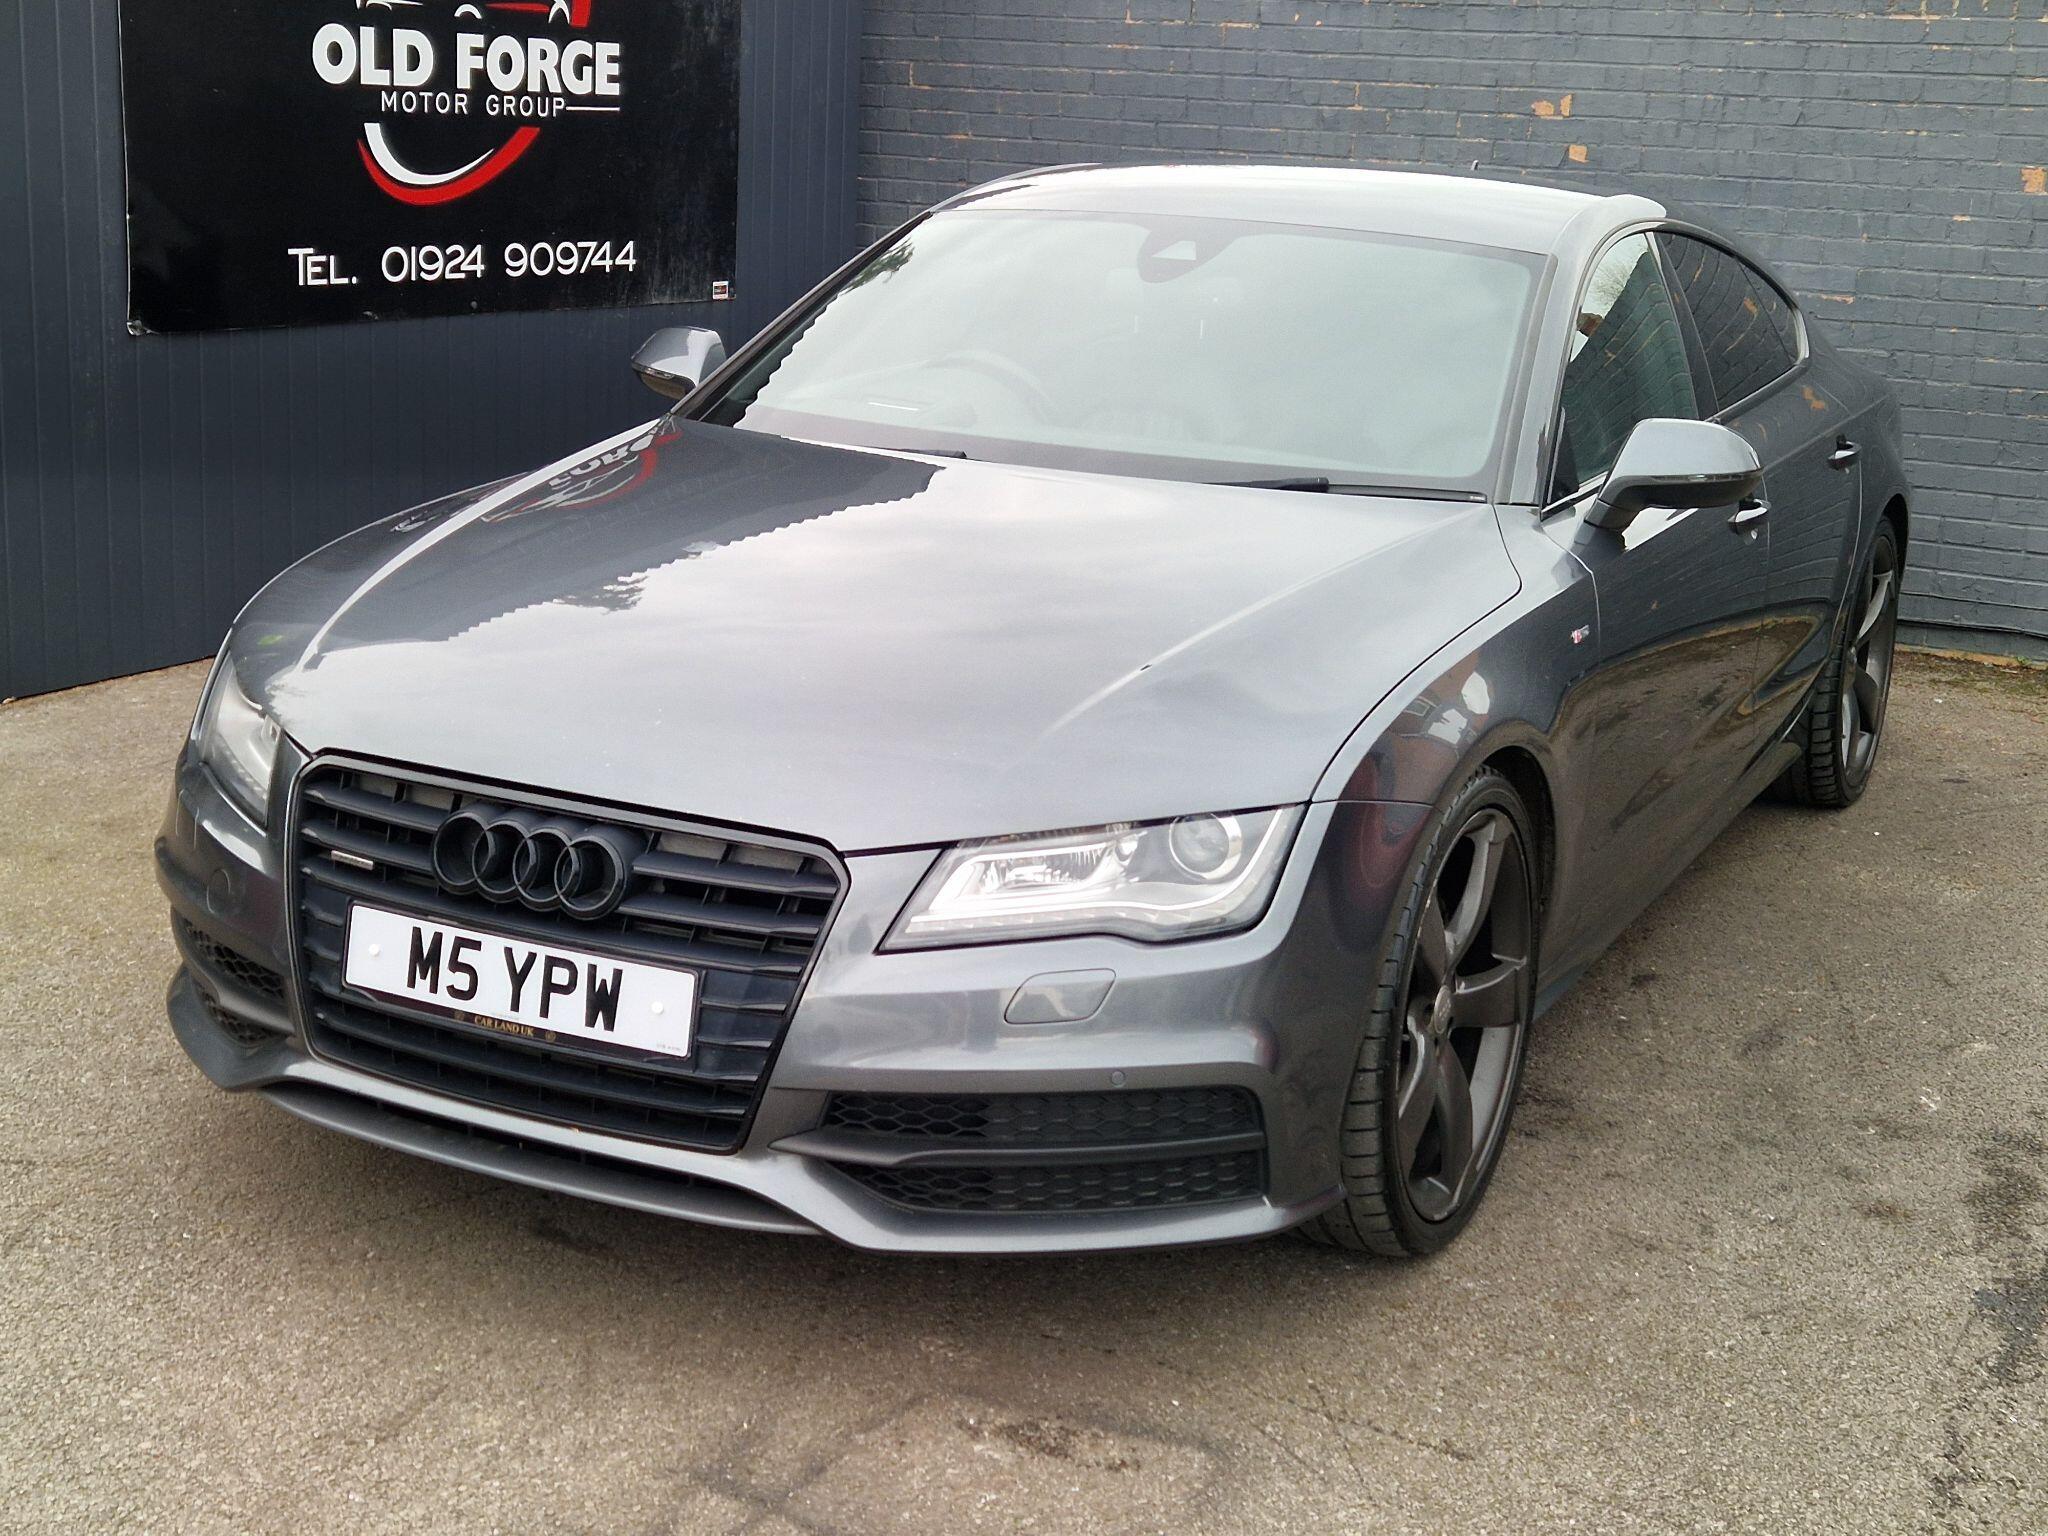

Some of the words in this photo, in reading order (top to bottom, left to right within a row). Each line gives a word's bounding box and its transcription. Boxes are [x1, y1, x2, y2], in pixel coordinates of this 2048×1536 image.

[312, 23, 435, 87] OLD
[456, 32, 621, 97] FORGE
[381, 91, 469, 115] MOTOR
[485, 94, 566, 119] GROUP
[382, 244, 485, 283] 01924
[504, 240, 638, 277] 909744
[406, 926, 482, 1001] M5
[503, 946, 623, 1032] YPW
[474, 1015, 493, 1028] CAR
[494, 1018, 520, 1034] LAND
[521, 1025, 534, 1038] UK
